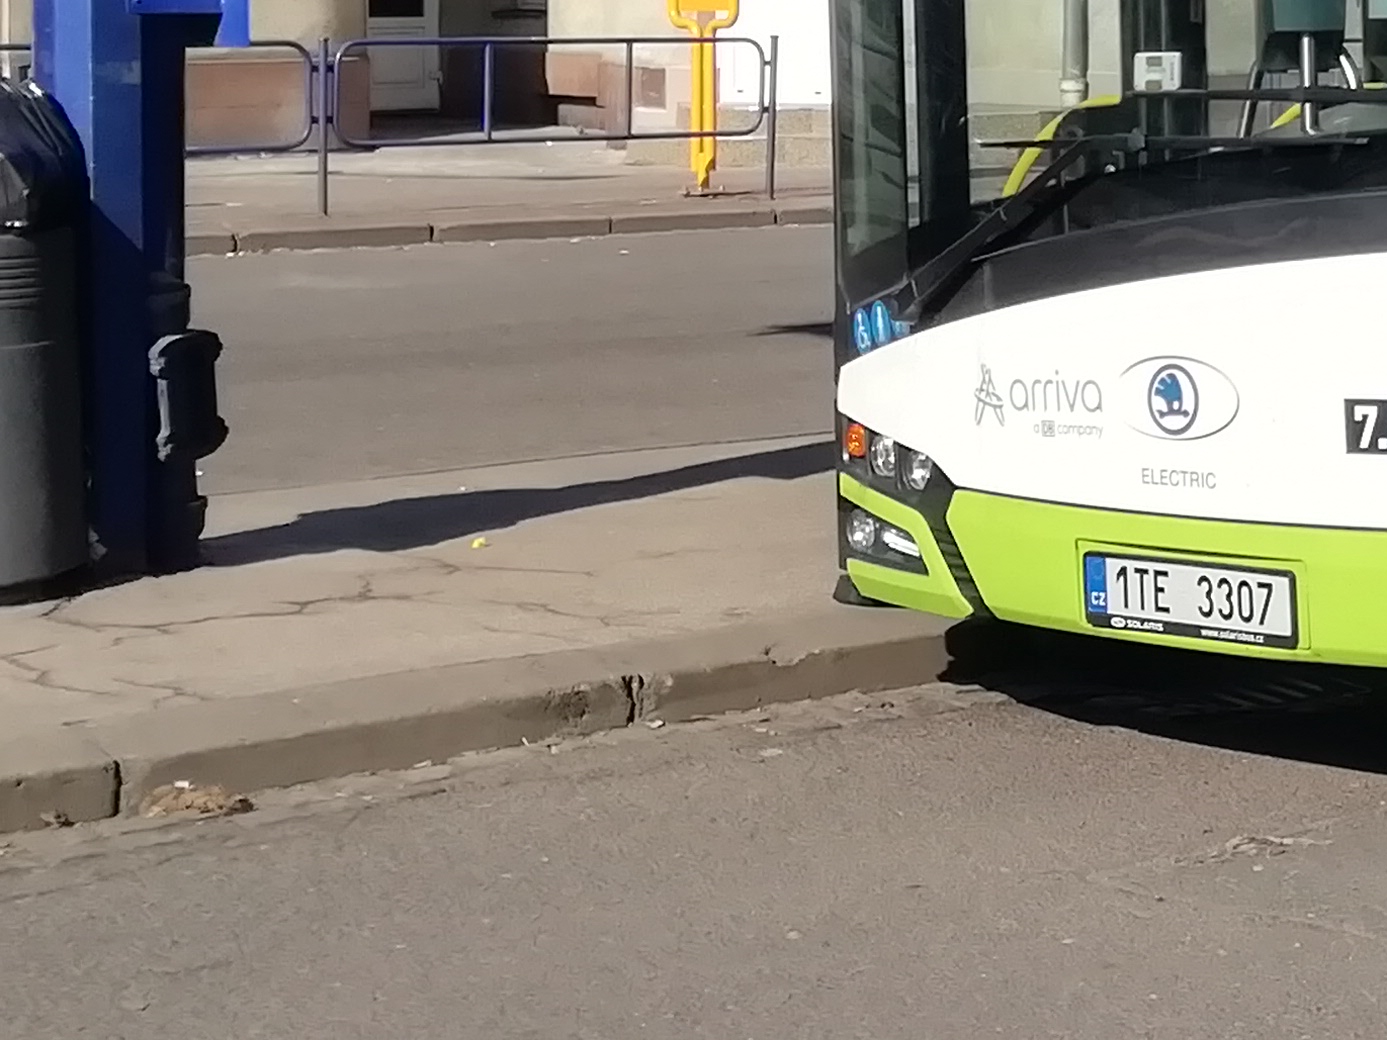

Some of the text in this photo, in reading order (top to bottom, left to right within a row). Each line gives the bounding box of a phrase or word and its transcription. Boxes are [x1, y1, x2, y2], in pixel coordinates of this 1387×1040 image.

[1009, 369, 1103, 412] arriva
[1056, 422, 1104, 439] company
[1141, 467, 1217, 490] ELECTRIC
[1091, 564, 1274, 627] CZ 1TE 3307
